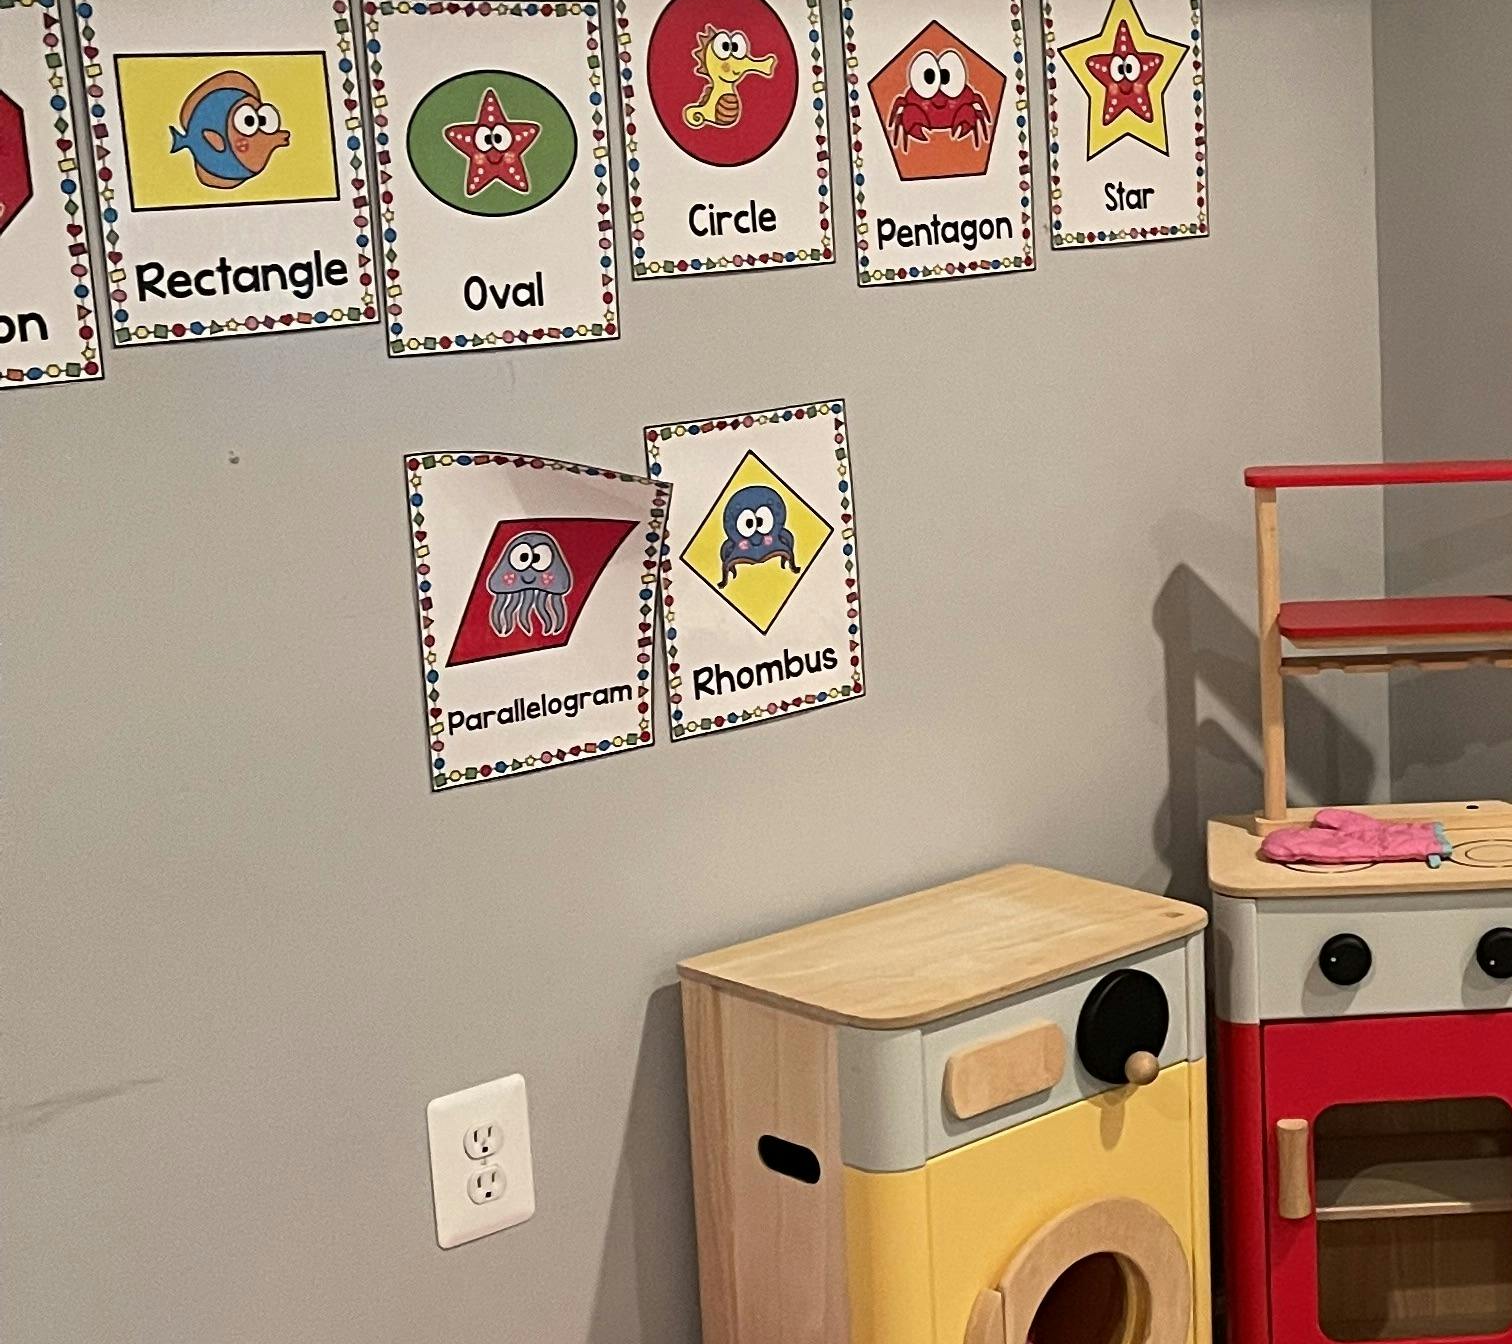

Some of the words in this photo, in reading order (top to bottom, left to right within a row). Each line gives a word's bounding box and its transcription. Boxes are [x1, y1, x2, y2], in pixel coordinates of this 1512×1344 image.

[1104, 181, 1155, 212] Star
[688, 199, 777, 237] Circle
[876, 213, 1013, 252] Pentagon
[135, 250, 349, 303] Rectangle
[463, 271, 544, 311] Oval
[692, 646, 839, 700] Rhombus
[447, 683, 633, 736] Parallelogram
